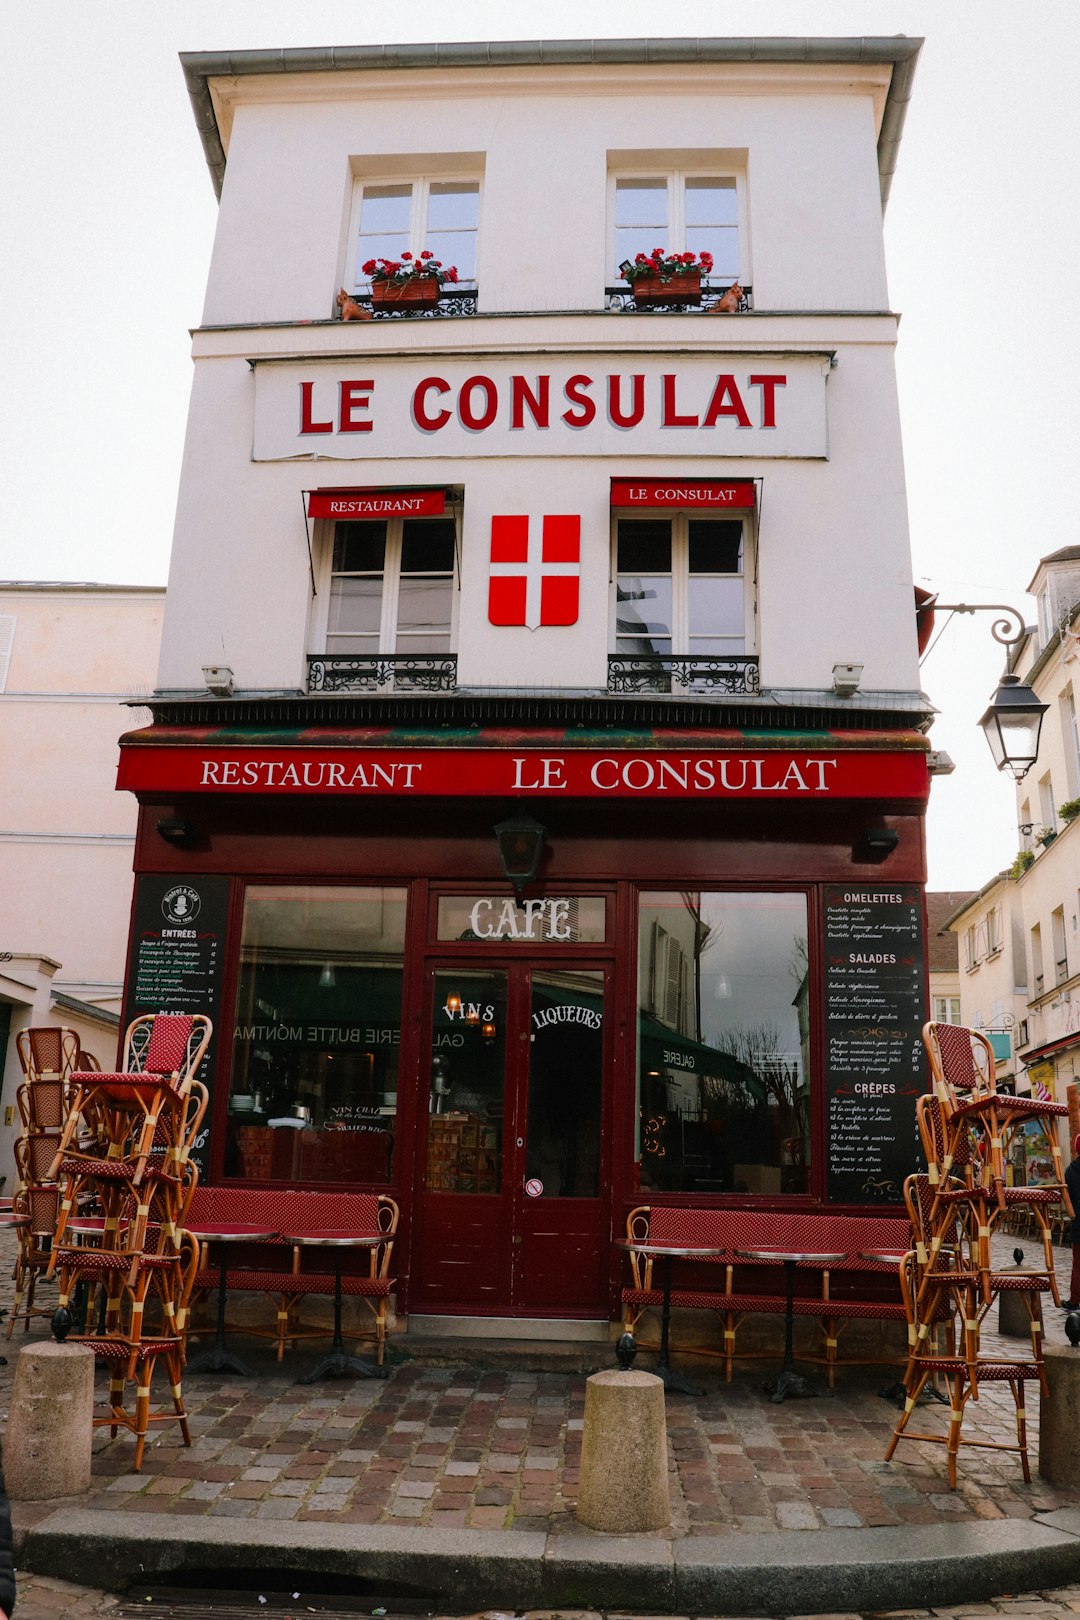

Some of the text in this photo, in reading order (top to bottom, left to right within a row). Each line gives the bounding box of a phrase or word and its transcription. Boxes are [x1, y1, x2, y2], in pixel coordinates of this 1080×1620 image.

[298, 374, 787, 437] LE CONSULAT
[629, 489, 736, 501] LE CONSULAT
[330, 499, 424, 512] RESTAURANT
[200, 761, 422, 788] RESTAURANT
[512, 758, 837, 791] LE CONSULAT
[844, 893, 903, 904] OMELETTES
[468, 899, 571, 939] CAFE
[162, 929, 197, 938] ENTRÉES
[850, 954, 897, 964] SALADES
[442, 1003, 495, 1022] VINS
[532, 1006, 603, 1029] LIQUEURS
[830, 1038, 849, 1048] Croque
[830, 1047, 849, 1057] Croque
[830, 1056, 848, 1065] Croque
[854, 1082, 896, 1094] CRÊPES
[332, 1106, 353, 1114] VIN
